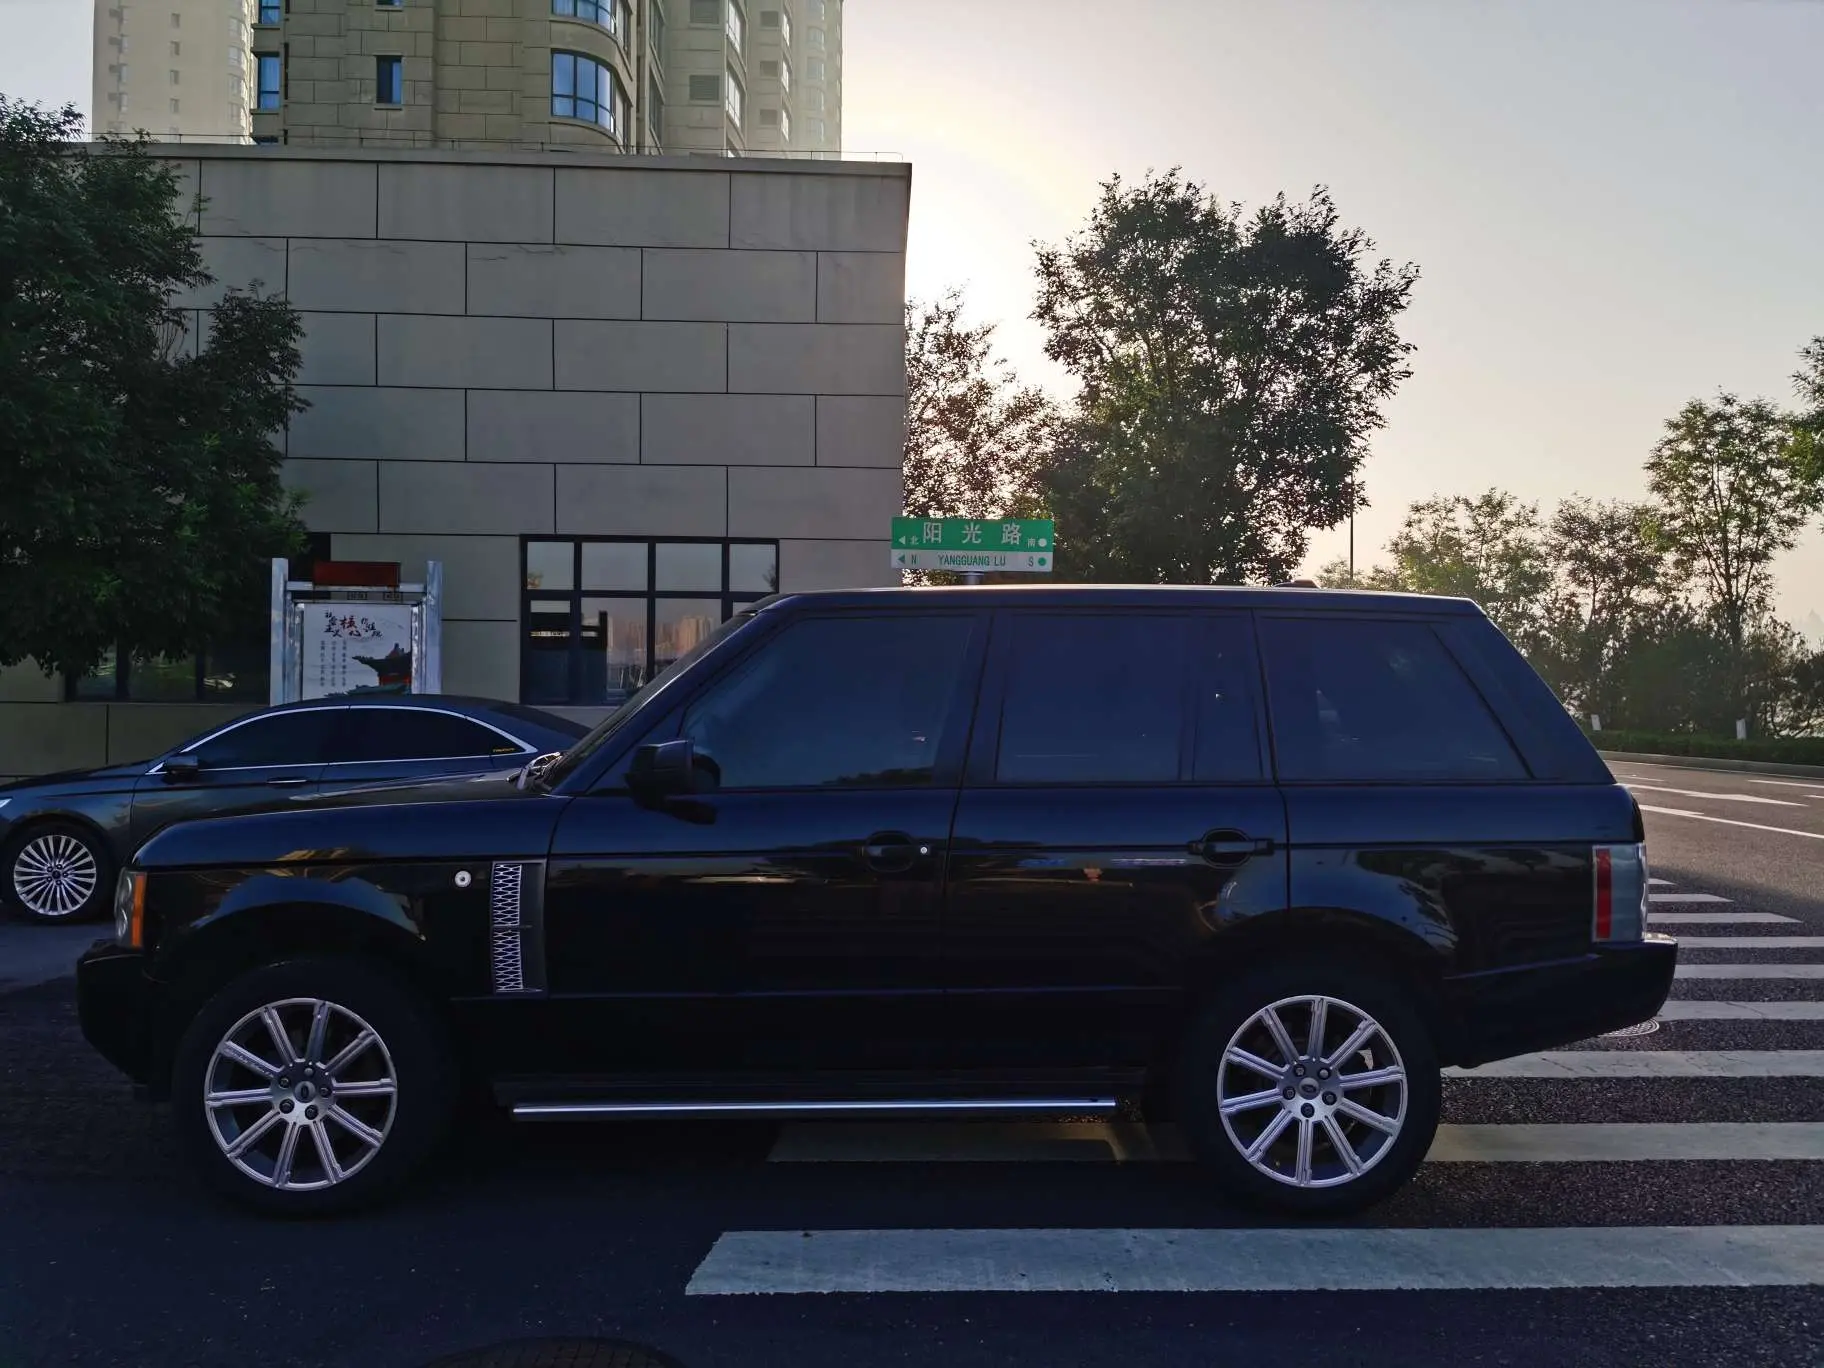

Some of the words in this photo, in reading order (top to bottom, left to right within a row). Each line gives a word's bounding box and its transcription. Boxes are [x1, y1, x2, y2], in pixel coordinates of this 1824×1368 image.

[923, 521, 1021, 545] 阳光路
[910, 535, 919, 545] 北
[1027, 537, 1036, 548] 南
[938, 555, 990, 566] YANGGUANG
[994, 556, 1006, 567] LU
[1028, 556, 1034, 567] S
